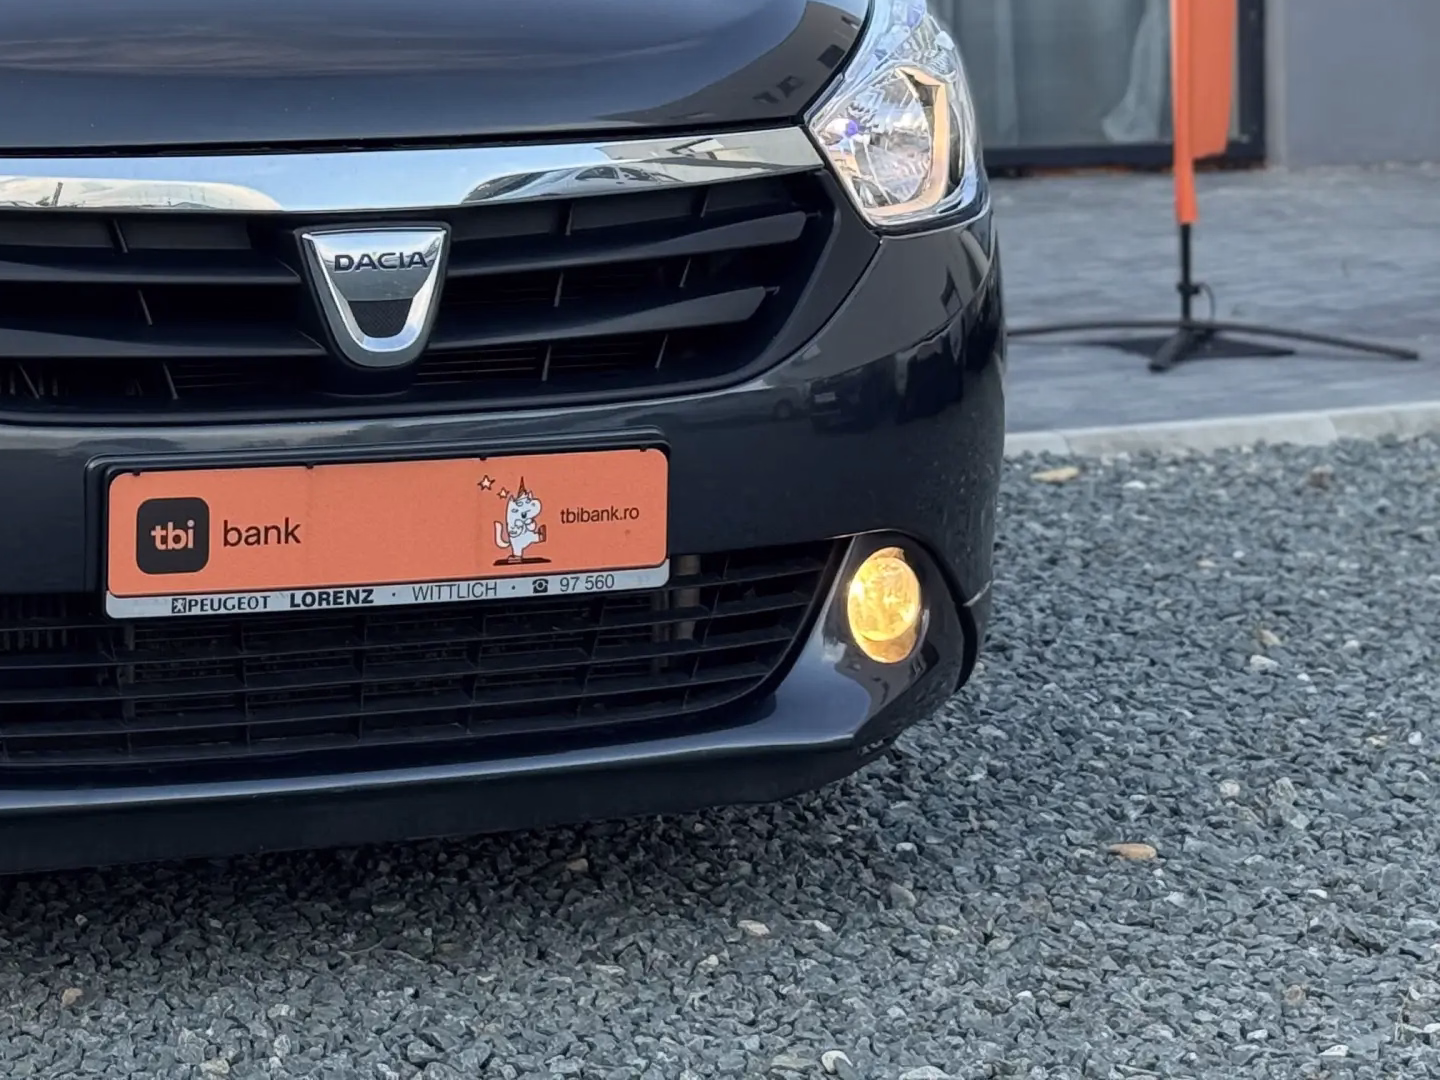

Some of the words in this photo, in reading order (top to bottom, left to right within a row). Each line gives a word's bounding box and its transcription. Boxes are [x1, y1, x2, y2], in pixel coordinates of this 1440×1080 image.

[334, 250, 428, 271] DACIA
[560, 505, 641, 524] tbibank.ro
[150, 519, 196, 551] tbi
[223, 517, 302, 547] bank
[187, 595, 272, 613] PEUGEOT
[289, 589, 375, 609] LORENZ
[411, 581, 498, 602] WITTLICH
[559, 576, 580, 592] 97
[584, 573, 616, 590] 560
